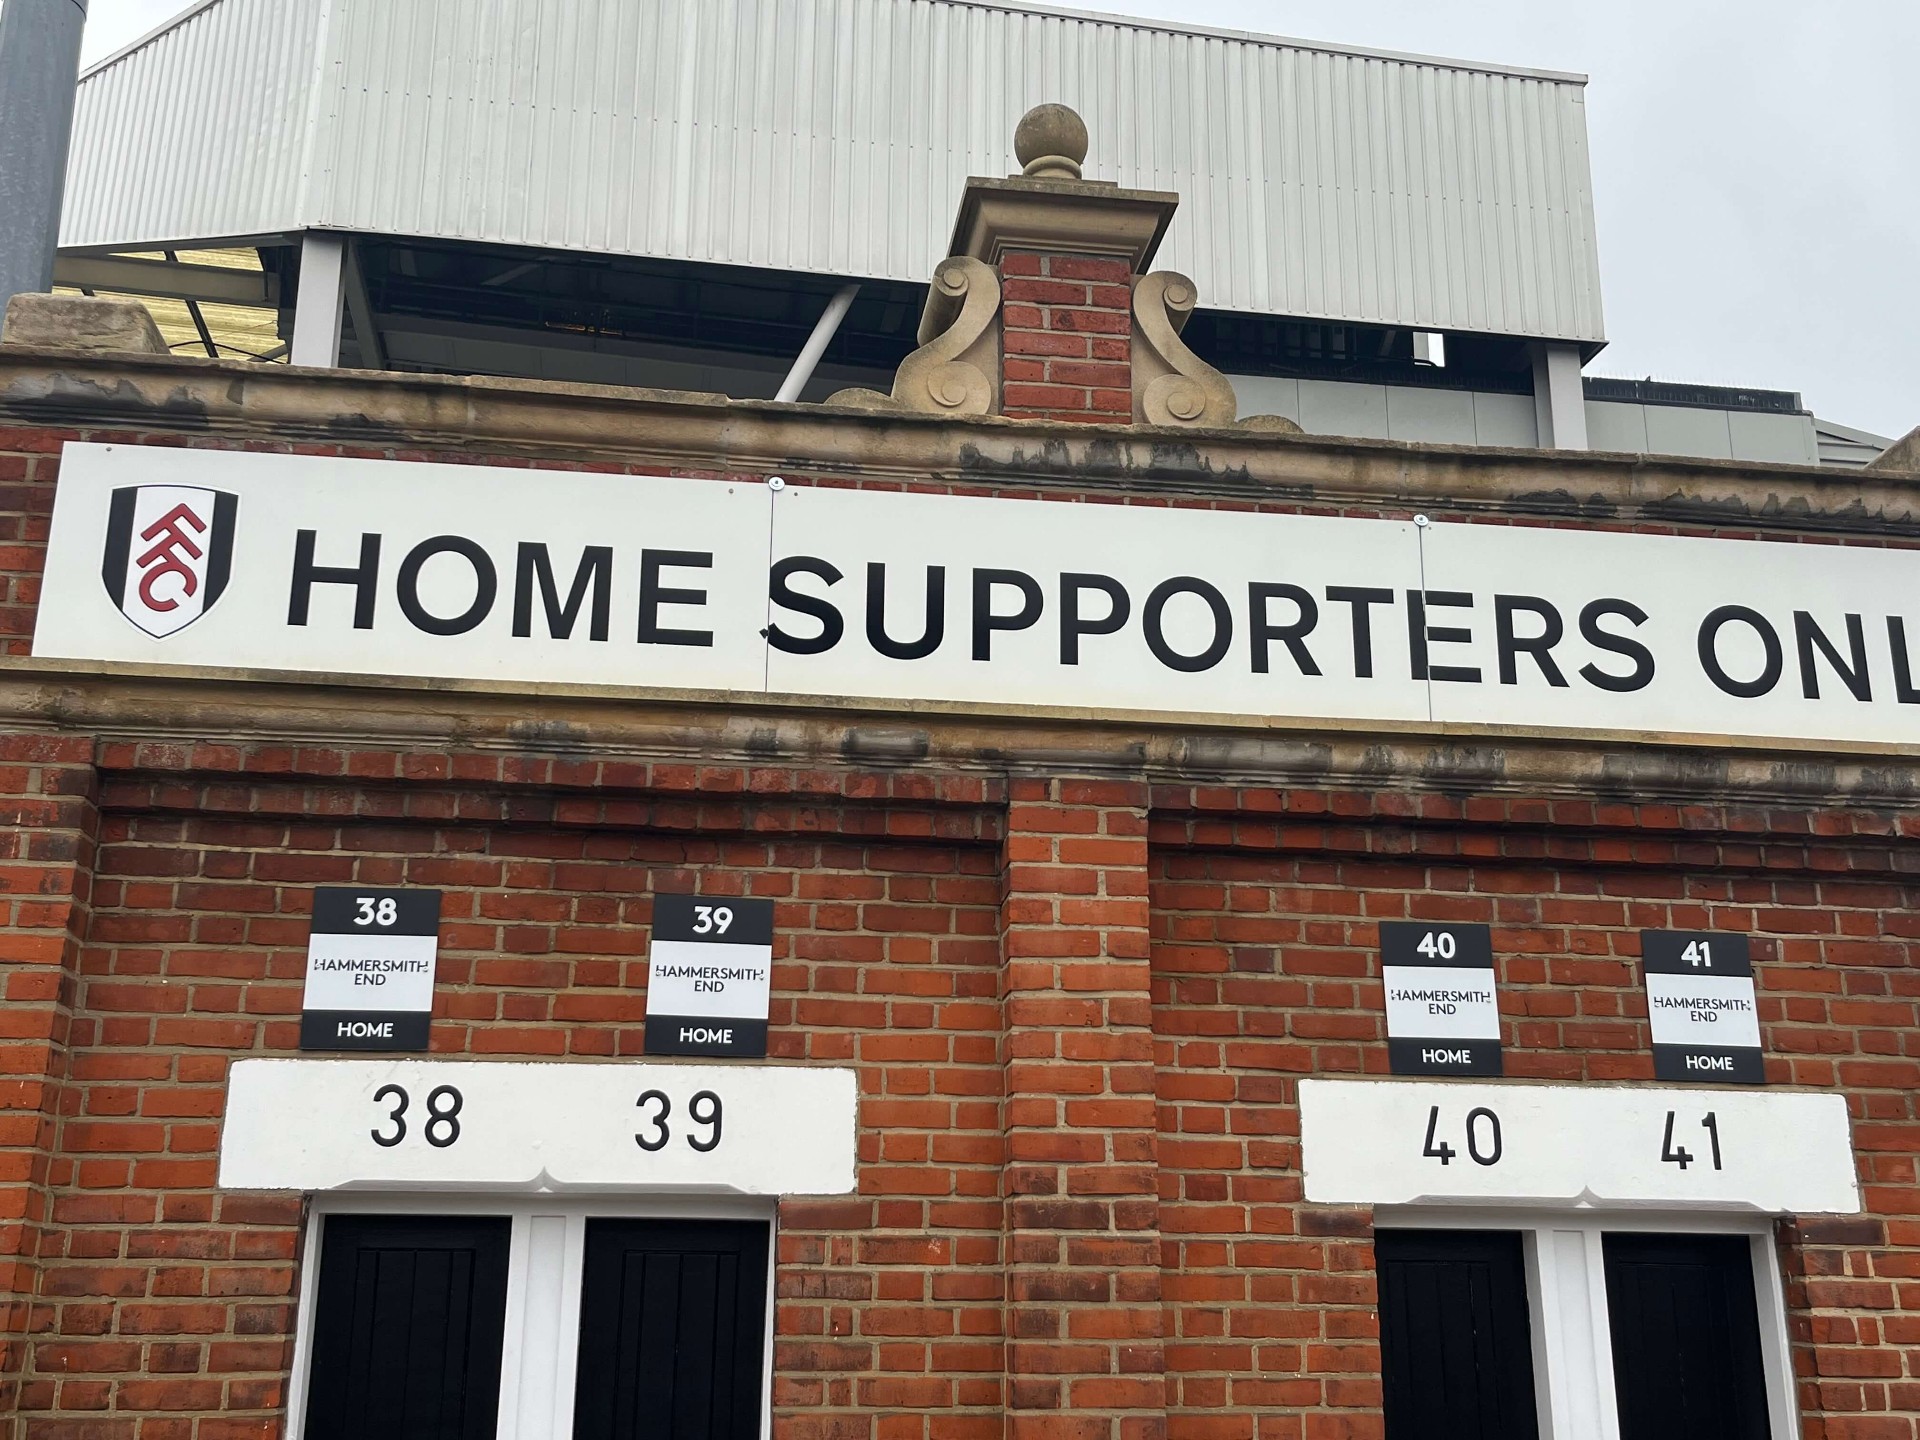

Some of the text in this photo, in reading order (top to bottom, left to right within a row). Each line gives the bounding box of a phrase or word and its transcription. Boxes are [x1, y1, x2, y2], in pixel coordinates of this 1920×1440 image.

[138, 503, 206, 612] FFC
[287, 529, 713, 647] HOME
[759, 555, 1655, 692] SUPPORTERS
[353, 897, 397, 925] 38
[692, 905, 733, 934] 39
[1416, 931, 1456, 958] 40
[1681, 940, 1712, 967] 41
[314, 959, 429, 973] HAMMERSMITH
[656, 965, 763, 981] HAMMERSMITH
[354, 973, 387, 986] END
[695, 980, 725, 993] END
[1391, 989, 1490, 1003] HAMMERSMITH
[1654, 996, 1751, 1011] HAMMERSMITH
[1428, 1003, 1457, 1015] END
[1690, 1010, 1718, 1023] END
[337, 1021, 394, 1038] HOME
[680, 1027, 733, 1044] HOME
[1422, 1048, 1472, 1064] HOME
[1685, 1055, 1734, 1071] HOME
[371, 1084, 463, 1148] 38
[635, 1090, 722, 1152] 39
[1423, 1106, 1502, 1166] 40
[1661, 1111, 1722, 1171] 41
